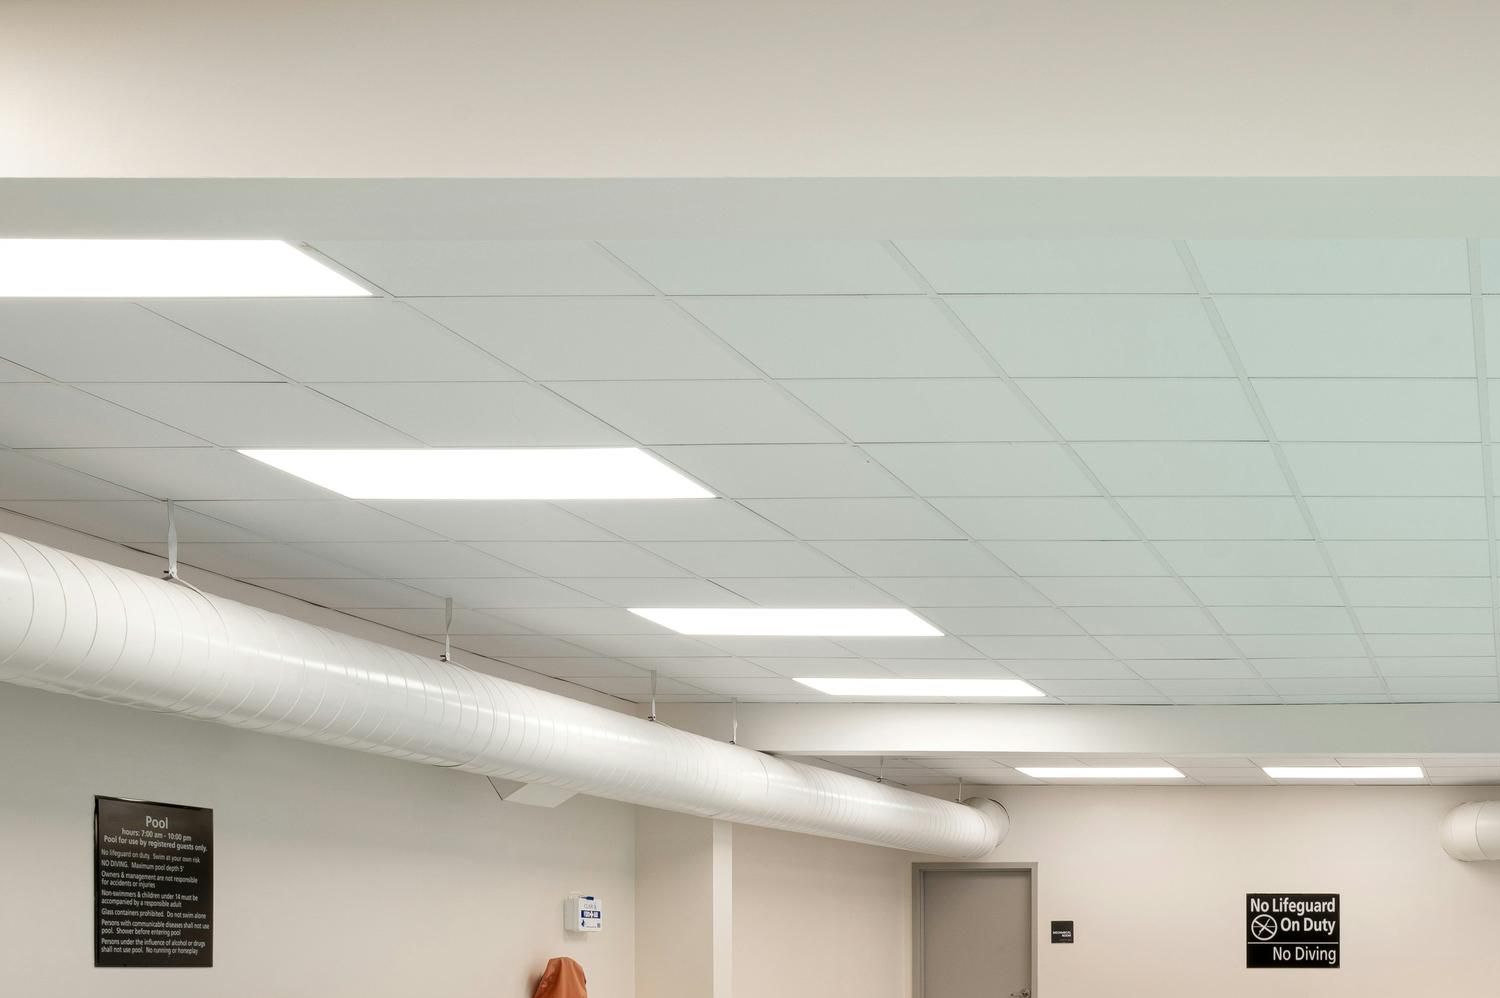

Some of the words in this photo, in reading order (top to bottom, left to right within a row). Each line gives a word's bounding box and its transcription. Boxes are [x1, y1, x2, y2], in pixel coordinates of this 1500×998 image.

[145, 816, 168, 829] Pool
[104, 835, 117, 843] Pool
[118, 836, 127, 844] for
[140, 838, 147, 847] by
[148, 840, 175, 849] registered
[195, 845, 207, 853] only.
[110, 849, 131, 858] lifeguard
[166, 865, 179, 873] depth
[126, 873, 156, 881] management
[174, 876, 198, 884] responsible
[139, 881, 155, 889] injuries
[101, 889, 136, 898] Non-swimmers
[142, 891, 160, 899] children
[1250, 898, 1269, 912] No
[1272, 897, 1335, 916] Lifeguard
[132, 920, 164, 928] communicable
[1281, 917, 1300, 931] On
[1304, 917, 1336, 935] Duty
[101, 937, 119, 945] Persons
[144, 938, 165, 946] influence
[193, 940, 205, 948] drugs
[153, 947, 171, 955] running
[178, 946, 198, 955] horseplay
[1273, 946, 1291, 961] No
[1295, 946, 1336, 964] Diving
